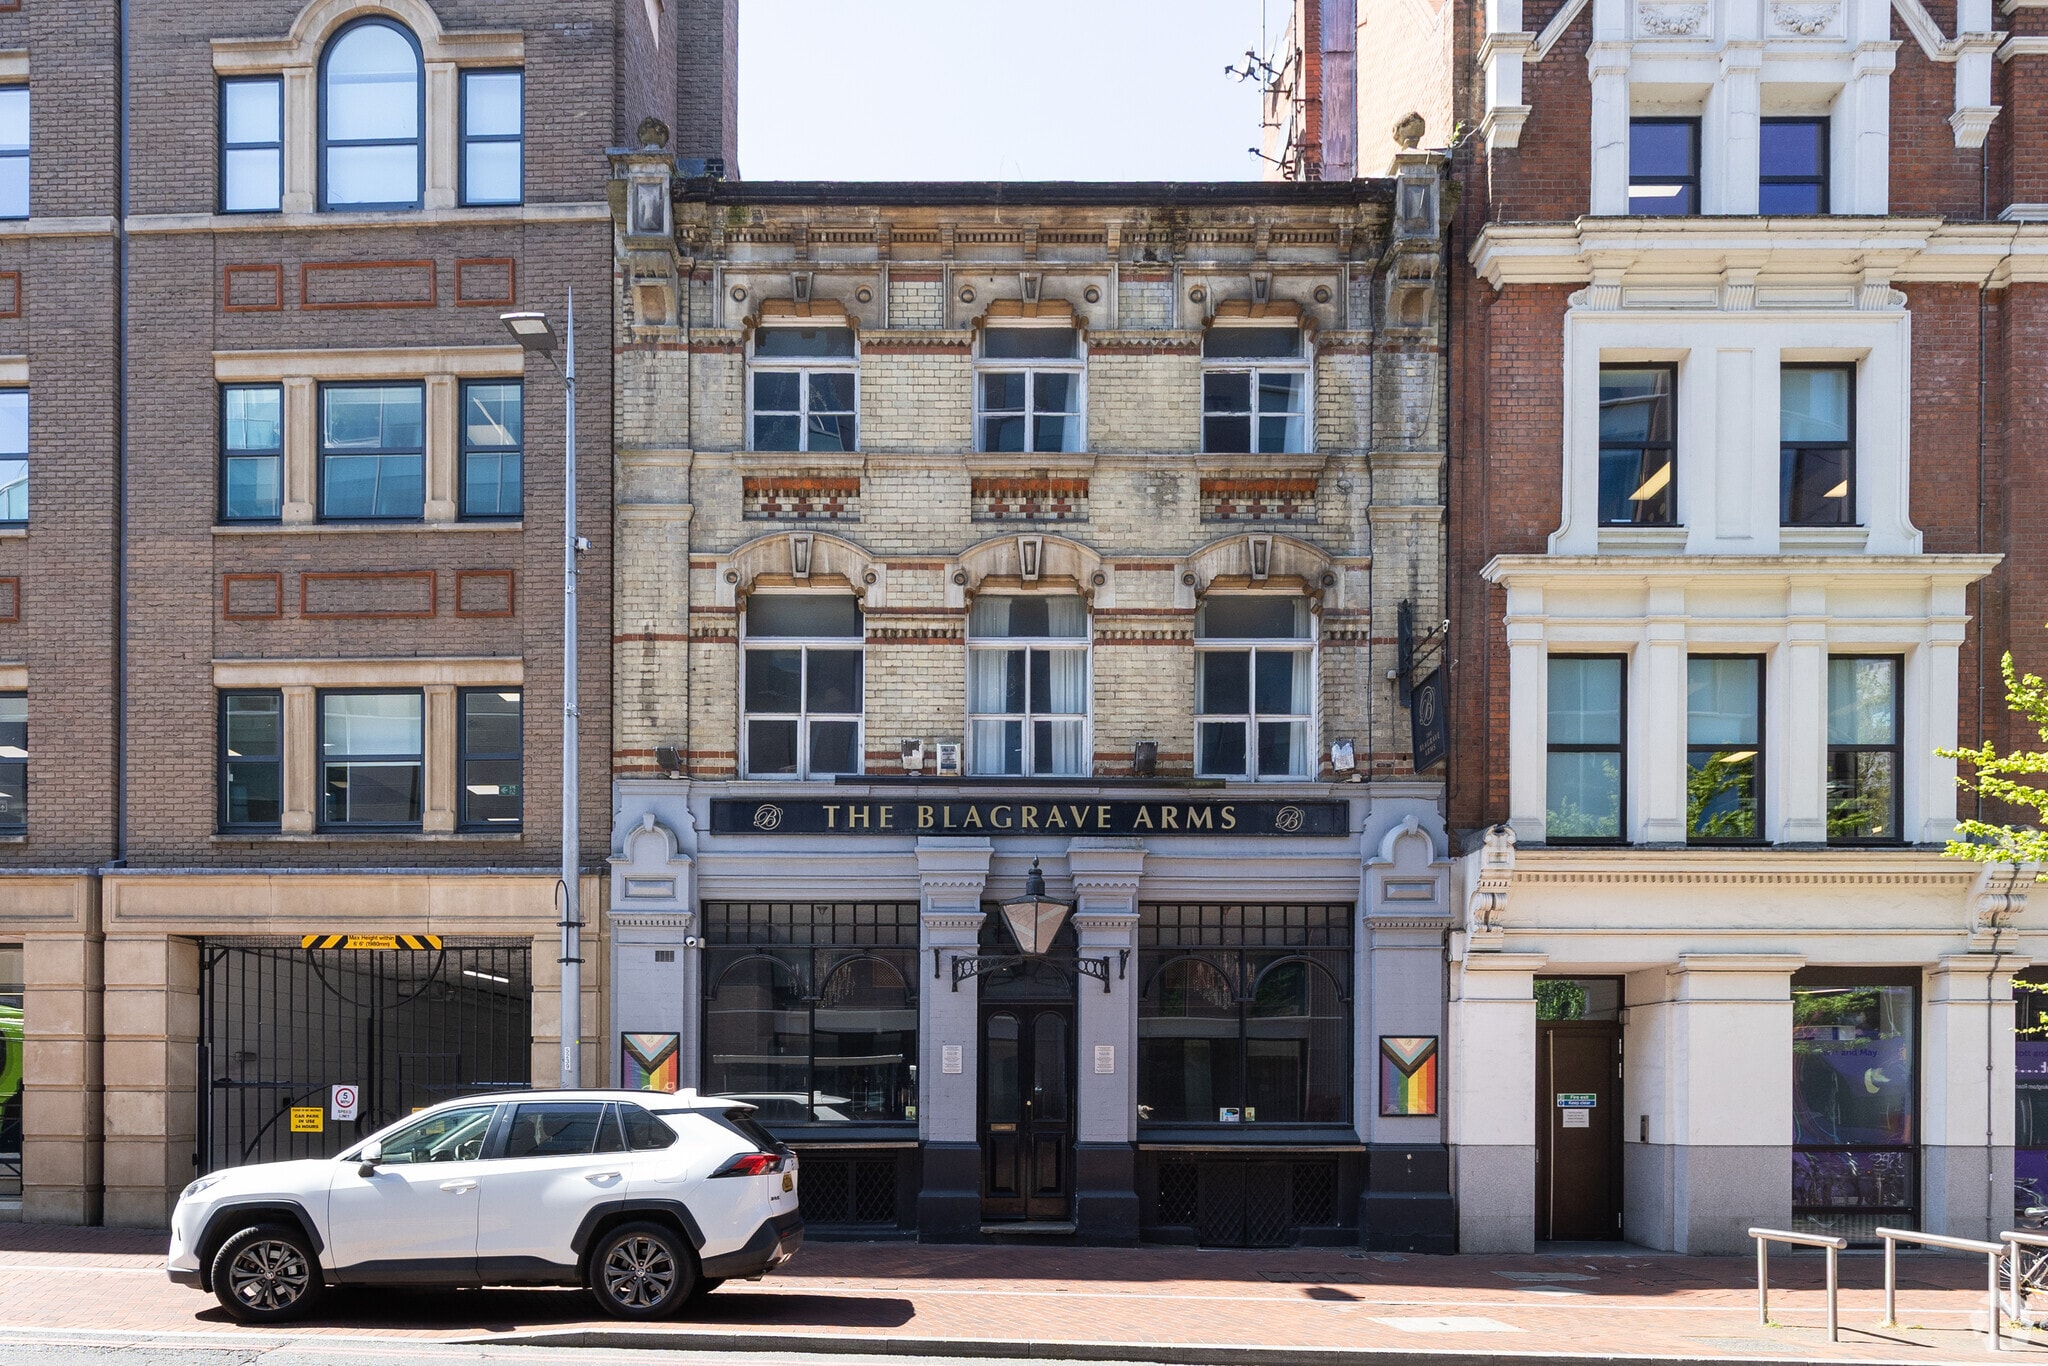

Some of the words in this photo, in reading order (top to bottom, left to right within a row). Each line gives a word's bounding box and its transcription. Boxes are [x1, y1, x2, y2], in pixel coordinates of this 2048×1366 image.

[822, 805, 893, 828] THE
[918, 805, 1111, 829] BLAGRAVE
[1133, 805, 1237, 829] ARMS
[1859, 1049, 1878, 1058] May
